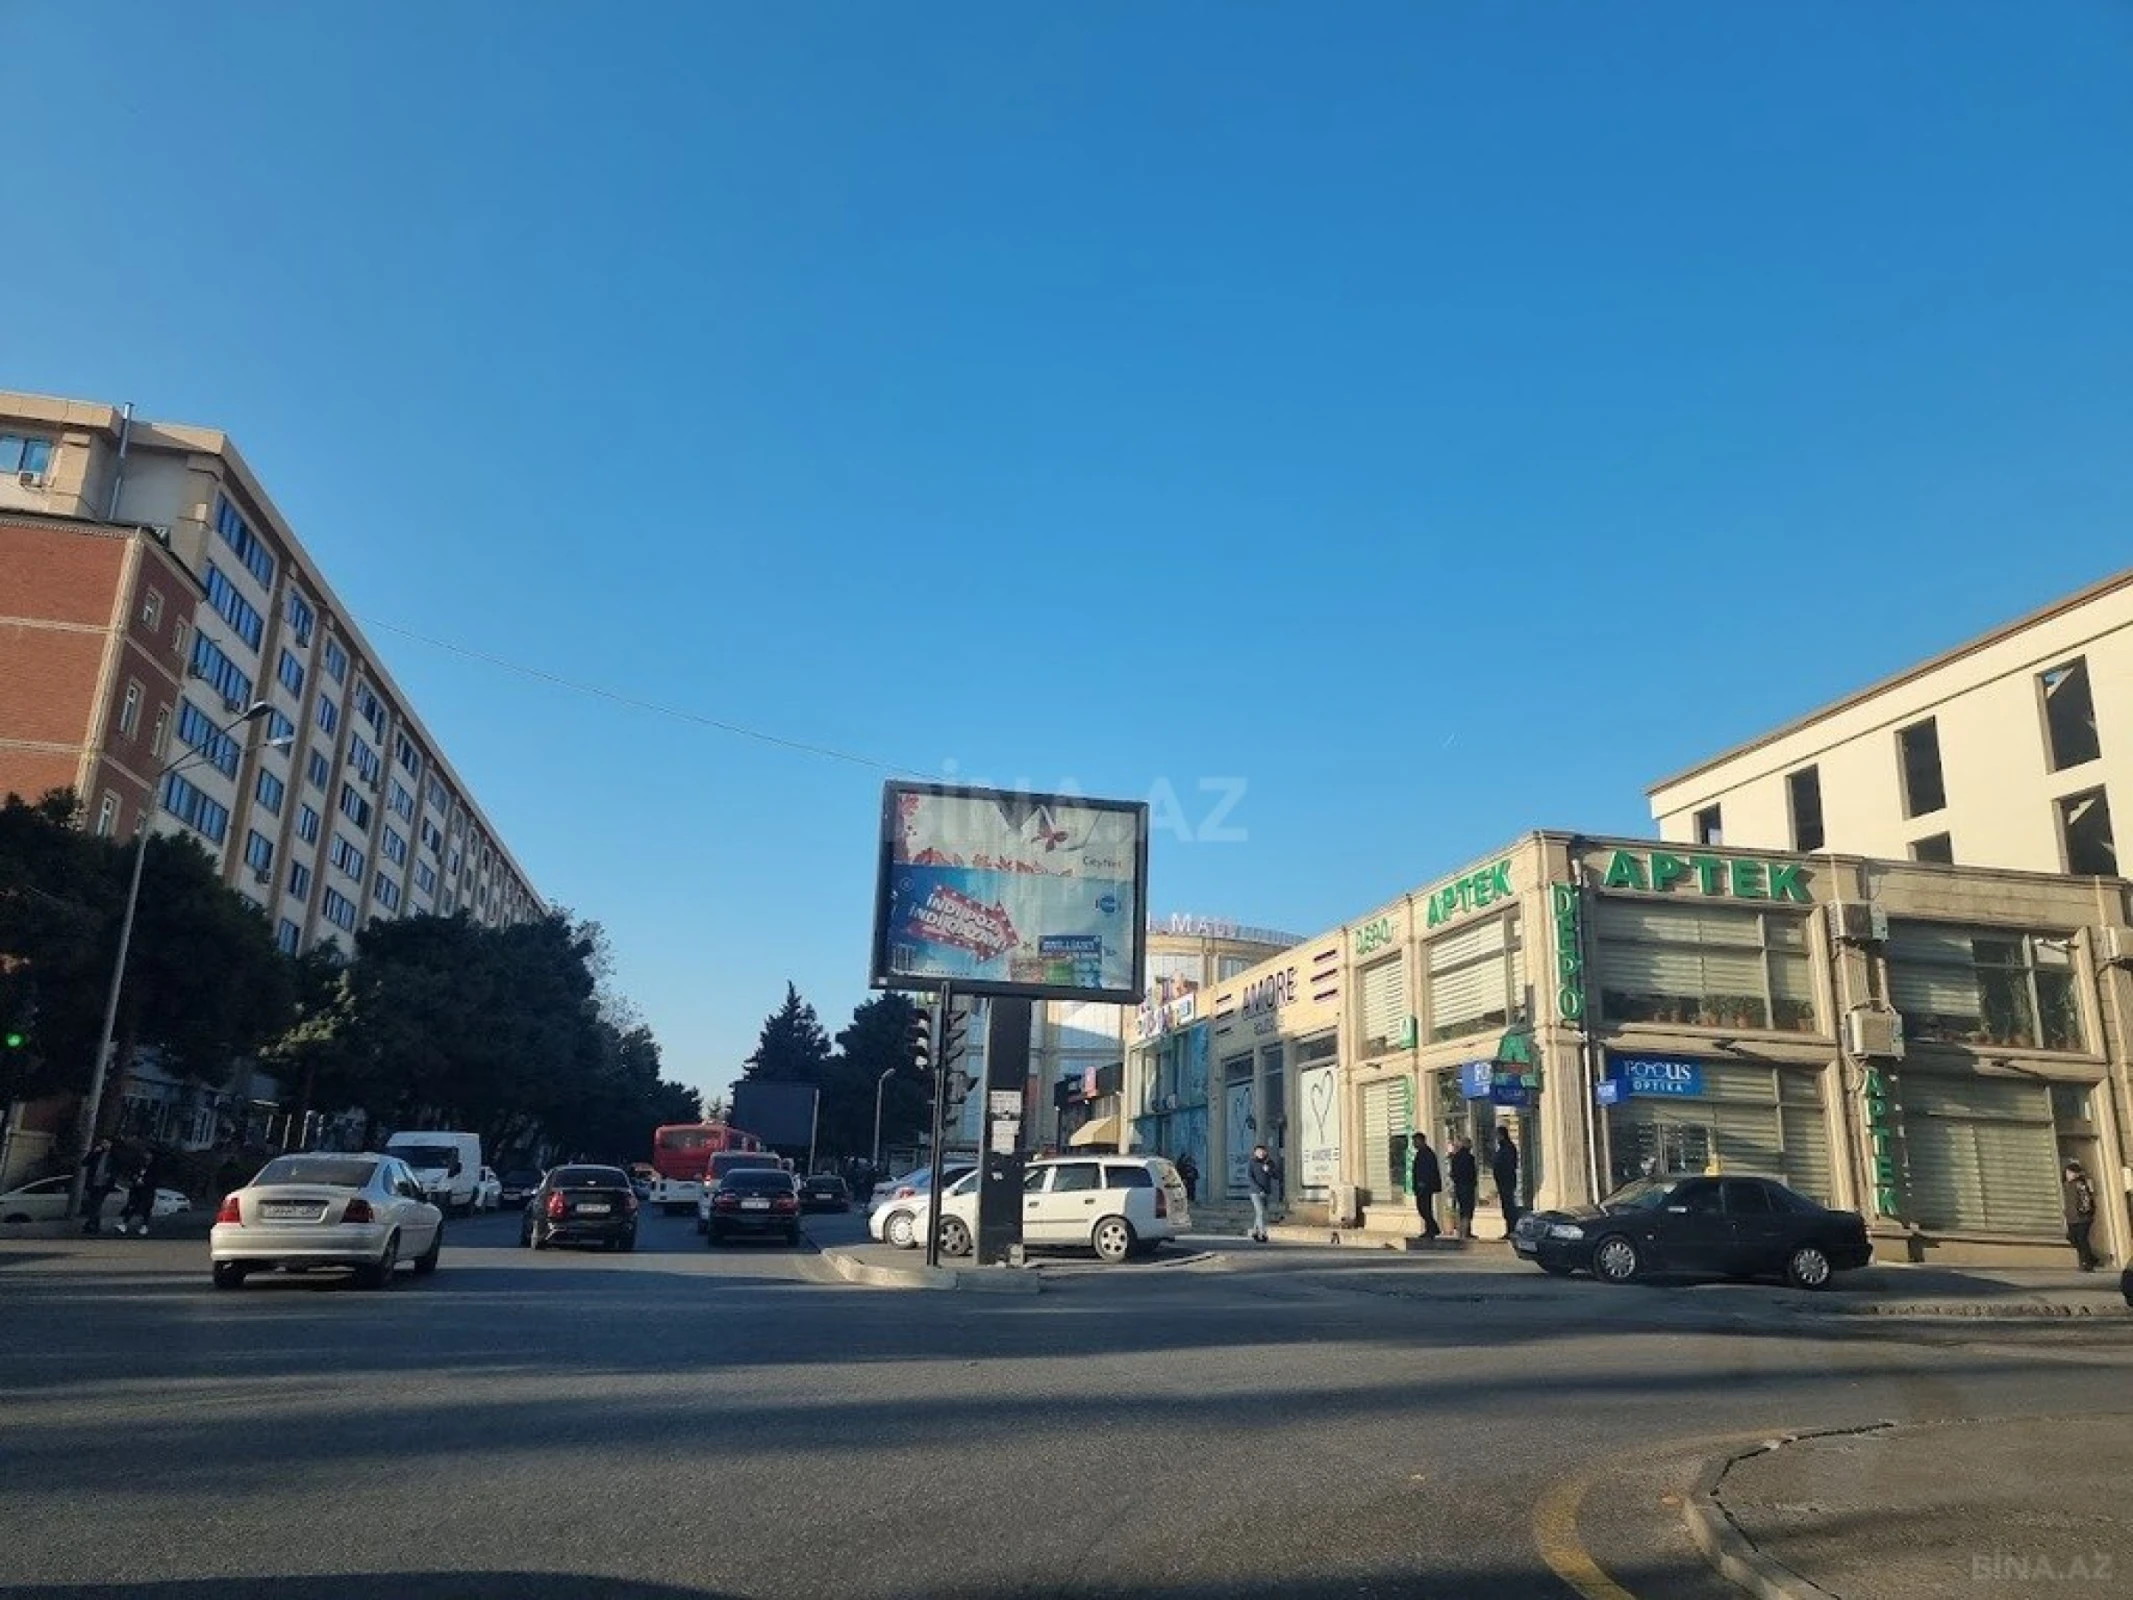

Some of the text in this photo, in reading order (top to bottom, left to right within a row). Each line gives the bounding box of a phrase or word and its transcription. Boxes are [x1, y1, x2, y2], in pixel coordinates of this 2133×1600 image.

[1425, 859, 1513, 928] APTEK
[1604, 850, 1814, 902] APTEK
[1550, 882, 1584, 1019] DEPO
[1241, 966, 1297, 1020] AMORE
[1624, 1060, 1692, 1080] FOCUS
[1862, 1067, 1899, 1216] APTEK
